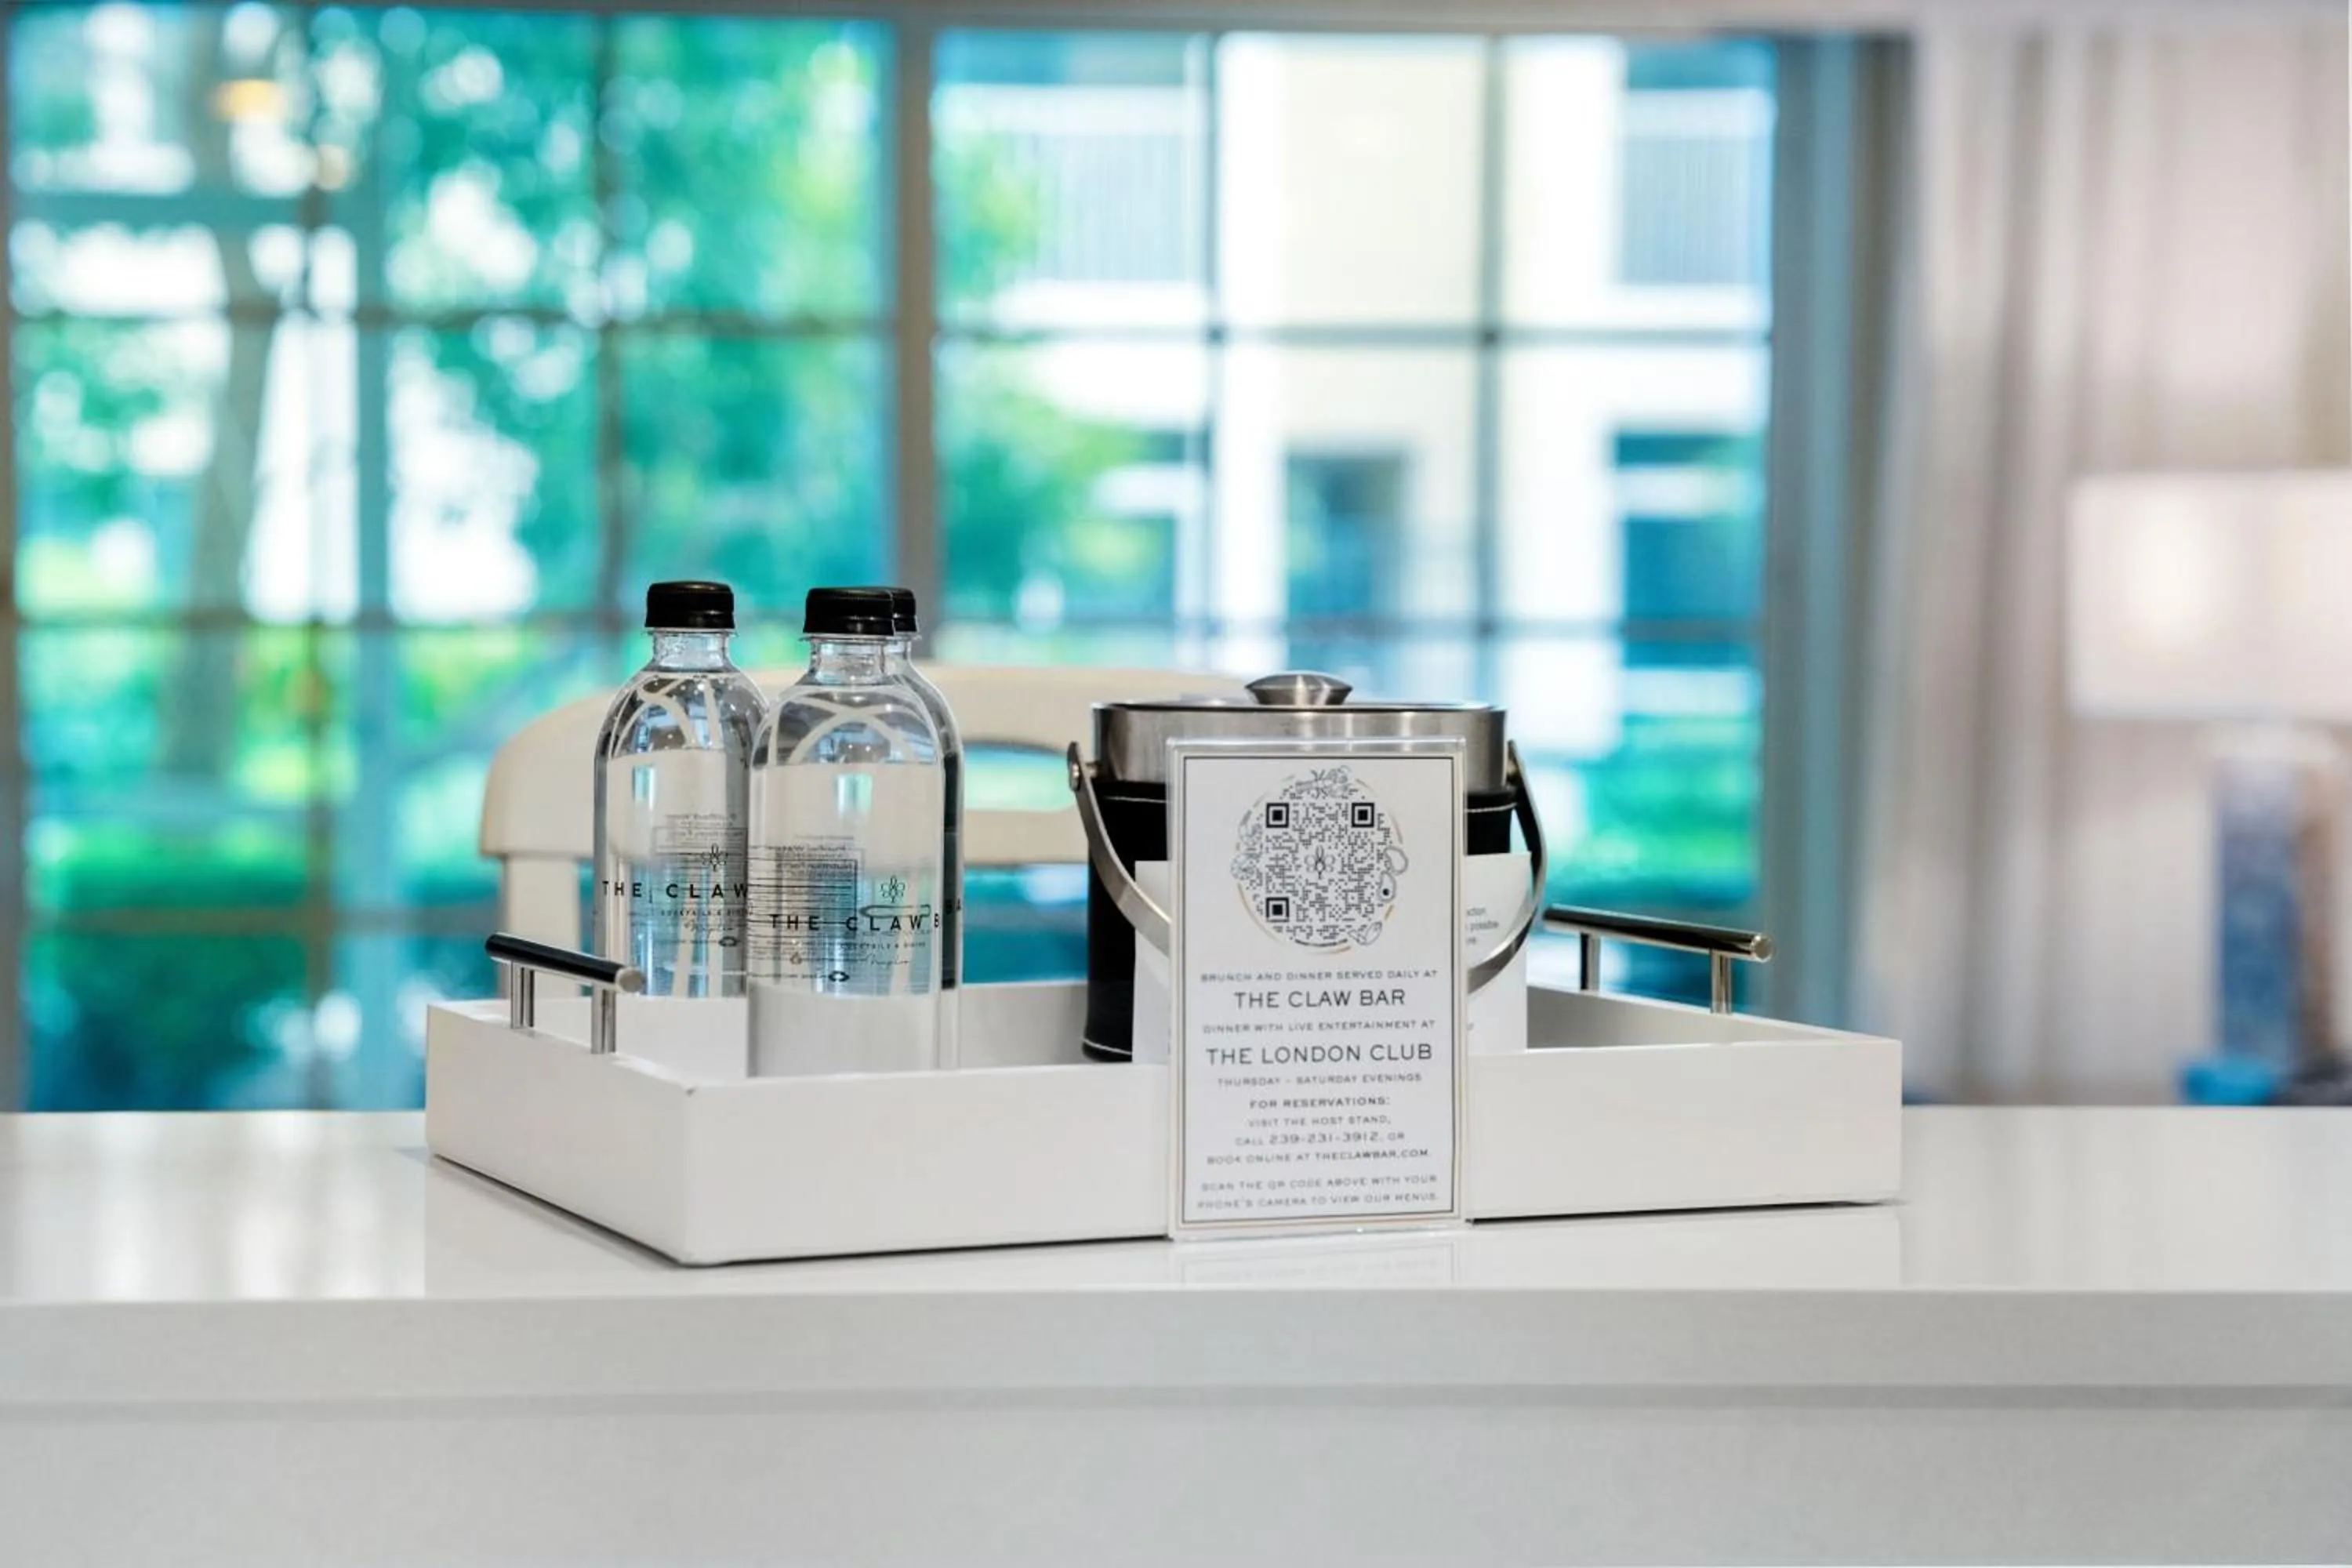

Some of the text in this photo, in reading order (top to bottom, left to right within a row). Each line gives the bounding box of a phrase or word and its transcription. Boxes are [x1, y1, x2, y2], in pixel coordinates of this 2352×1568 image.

[602, 880, 747, 898] THE CLAW
[769, 913, 819, 931] THE
[846, 914, 921, 931] CLAW
[1200, 973, 1252, 982] BRUNCH
[1256, 972, 1281, 981] AND
[1286, 971, 1332, 980] DINNER
[1336, 970, 1383, 979] SERVED
[1387, 970, 1419, 978] DAILY
[1233, 989, 1406, 1009] THE CLAW BAR
[1203, 1020, 1436, 1034] DINNER WITH LIVE ENTERTAINMENT AT
[1206, 1044, 1432, 1065] THE LONDON CLUB
[1218, 1076, 1280, 1087] THURSDAY
[1296, 1075, 1357, 1085] SATURDAY
[1362, 1073, 1422, 1083] EVENINGS
[1250, 1098, 1391, 1109] FOR RESERVATIONS:
[1248, 1115, 1392, 1127] VISIT THE HOST STAND,
[1235, 1137, 1265, 1146] CALL
[1387, 1131, 1405, 1142] OR
[1207, 1155, 1241, 1165] BOOK
[1246, 1153, 1291, 1163] ONLINE
[1201, 1174, 1438, 1191] SCAN THE QR CODE ABOVE WITH YOUR
[1258, 1196, 1307, 1207] CAMERA
[1312, 1195, 1327, 1205] TO
[1330, 1194, 1360, 1203] VIEW
[1365, 1193, 1391, 1203] OUR
